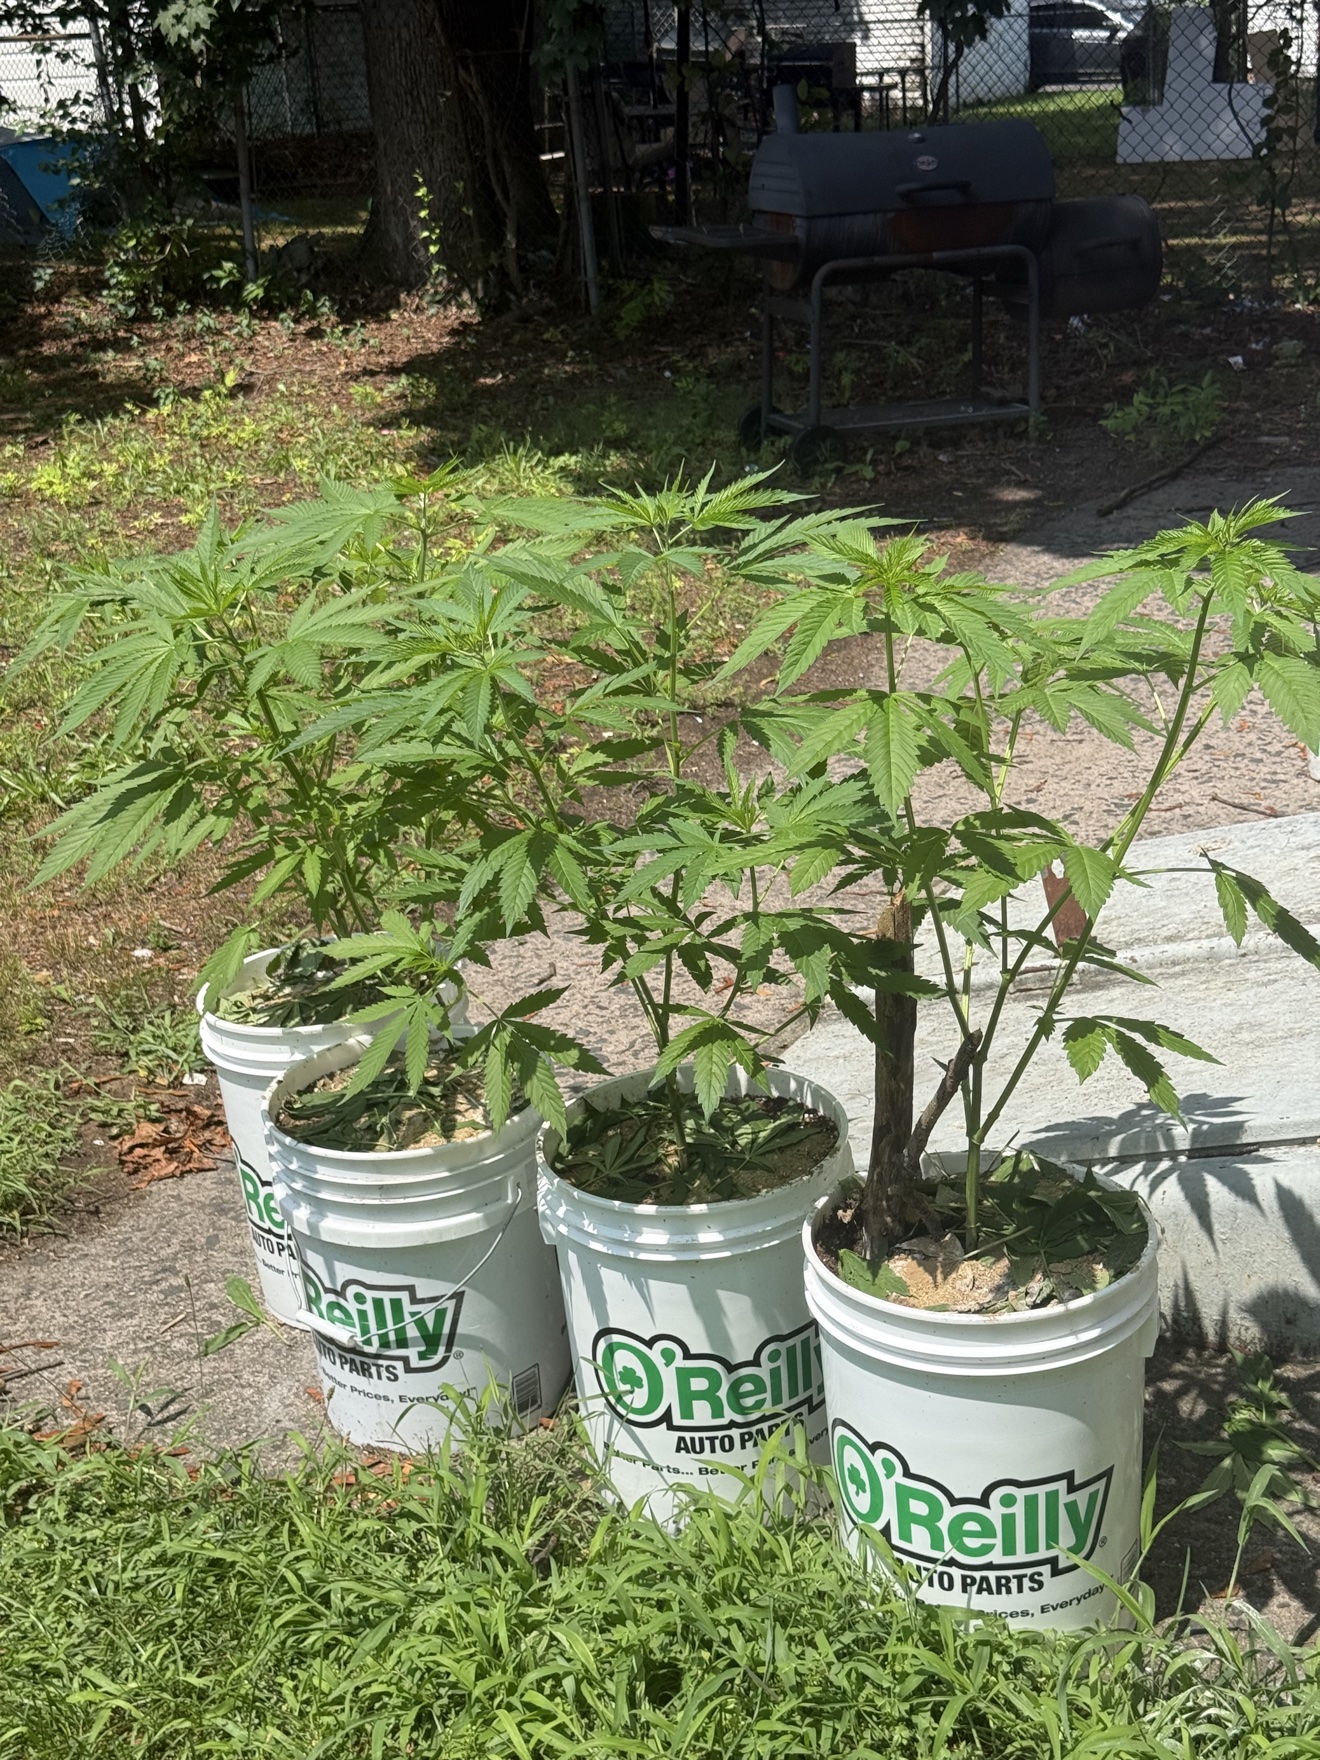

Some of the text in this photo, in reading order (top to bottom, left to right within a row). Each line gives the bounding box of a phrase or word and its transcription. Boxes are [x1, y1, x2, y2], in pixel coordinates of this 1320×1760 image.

[339, 1356, 399, 1382] PARTS
[350, 1385, 395, 1404] Prices,
[675, 1434, 735, 1455] AUTO
[837, 1433, 1100, 1558] O'Reilly
[961, 1570, 1045, 1596] PARTS
[1040, 1582, 1107, 1615] Everyday
